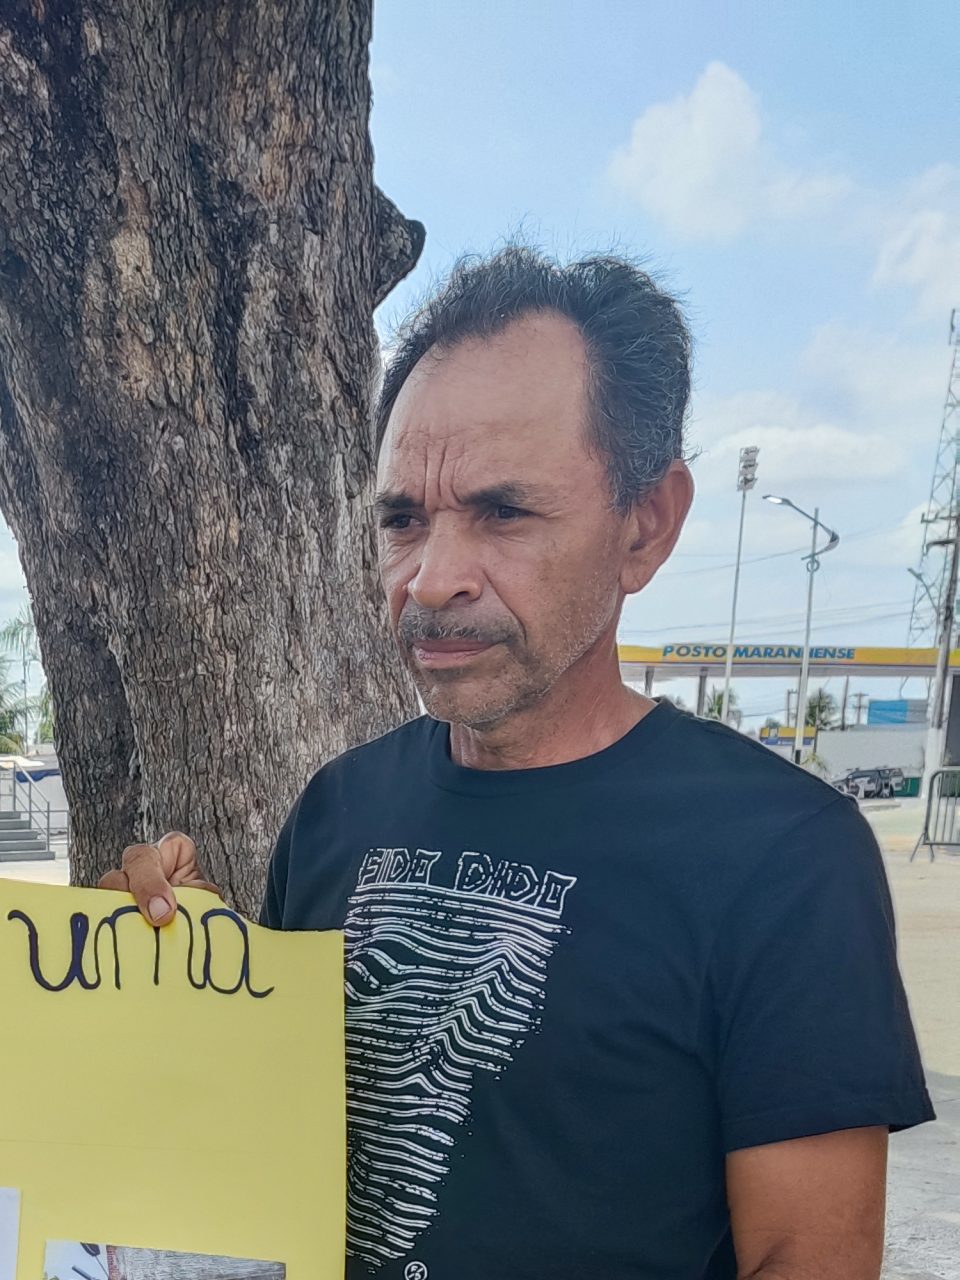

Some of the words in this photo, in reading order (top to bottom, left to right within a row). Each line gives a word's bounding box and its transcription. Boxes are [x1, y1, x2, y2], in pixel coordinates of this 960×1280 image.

[662, 644, 727, 658] POSTO
[357, 848, 442, 886] FIDO
[454, 851, 578, 909] DIDO
[7, 903, 276, 999] uma
